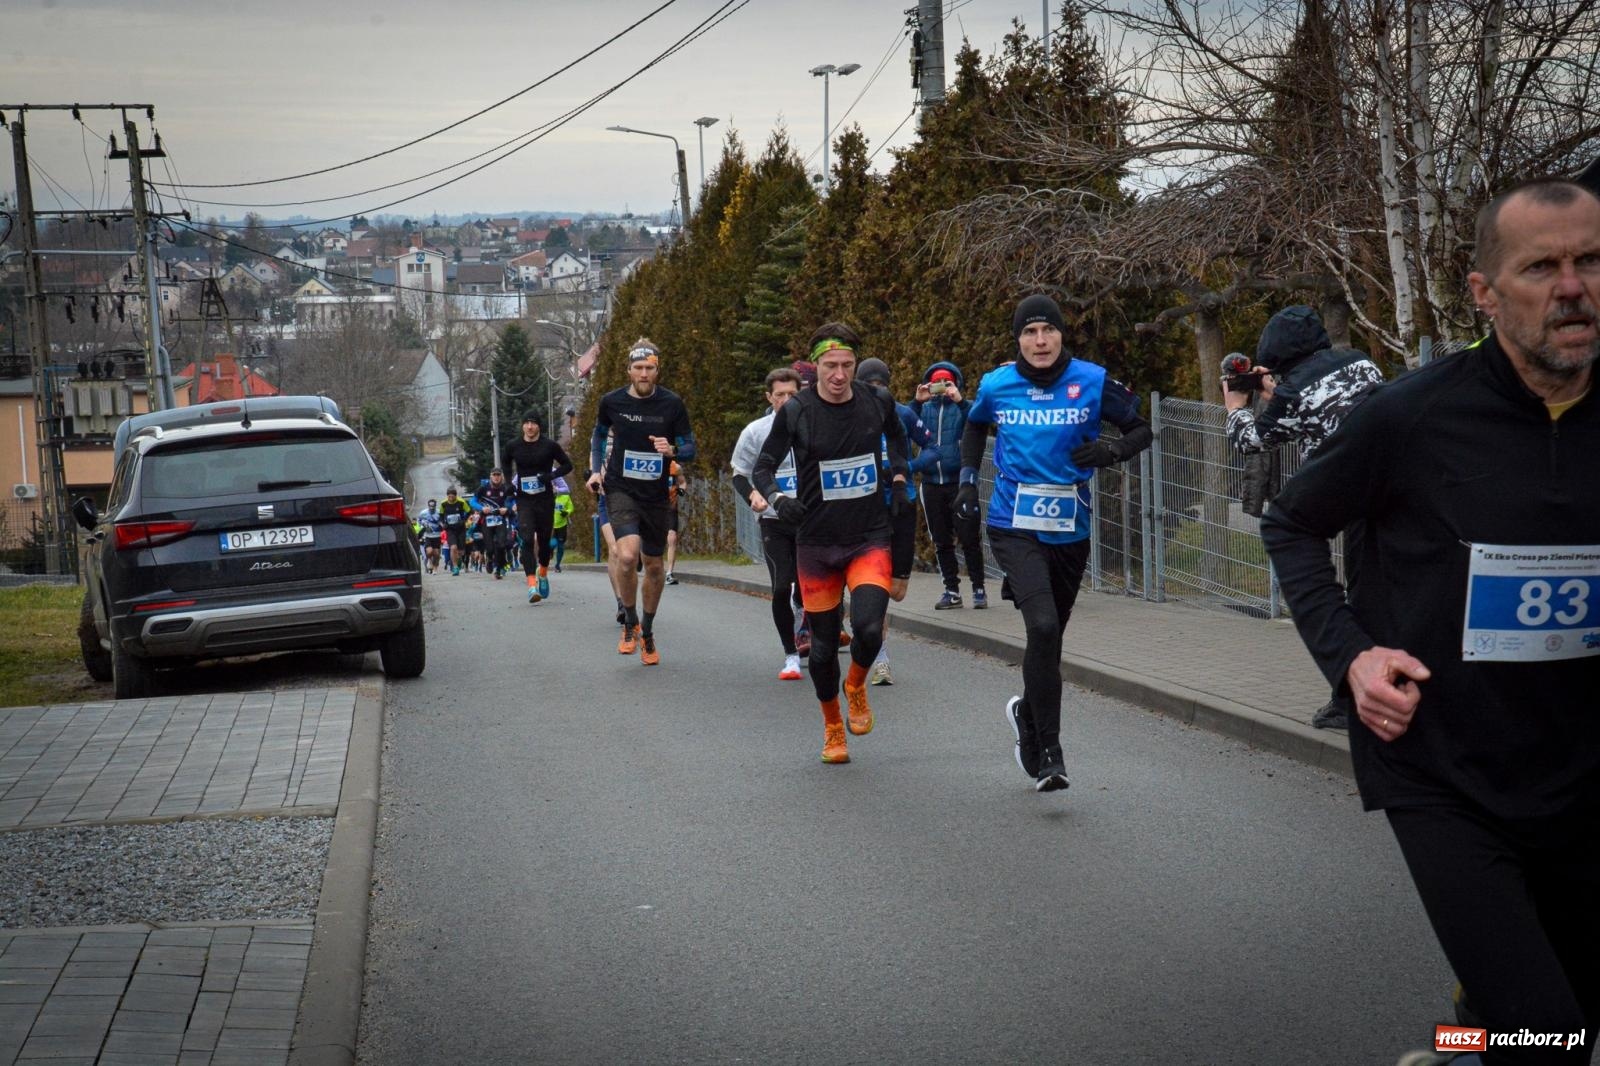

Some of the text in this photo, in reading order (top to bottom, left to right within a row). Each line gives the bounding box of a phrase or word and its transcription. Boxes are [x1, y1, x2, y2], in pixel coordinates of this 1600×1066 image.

[995, 407, 1090, 425] RUNNERS
[631, 460, 656, 472] 126
[832, 467, 868, 488] 176
[1032, 497, 1061, 517] 66
[231, 528, 309, 548] OP 1239P
[1516, 579, 1590, 626] 83
